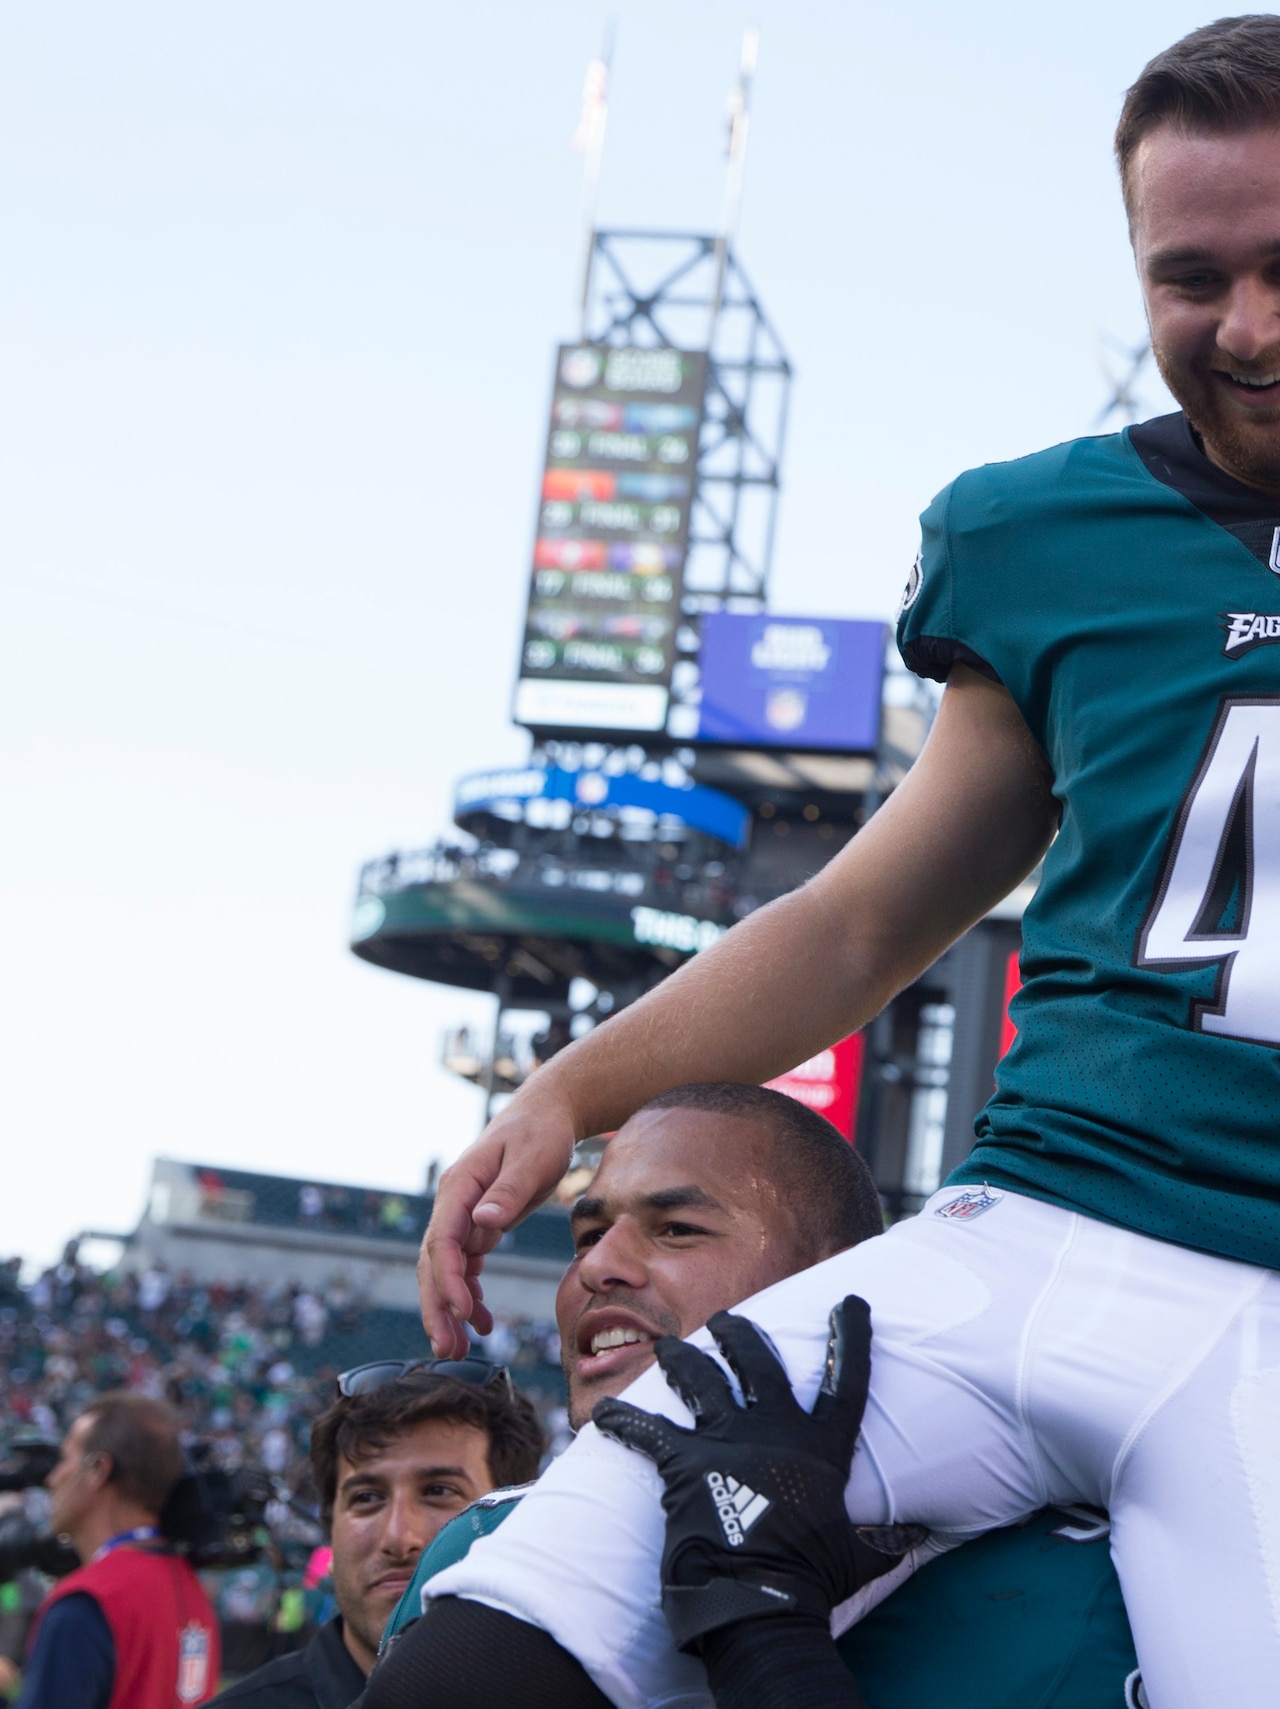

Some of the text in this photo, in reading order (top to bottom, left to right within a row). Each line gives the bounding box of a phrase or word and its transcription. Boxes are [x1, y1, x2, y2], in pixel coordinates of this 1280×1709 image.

[631, 906, 697, 951] THIS
[943, 1202, 978, 1217] NFL
[707, 1471, 744, 1546] adidas
